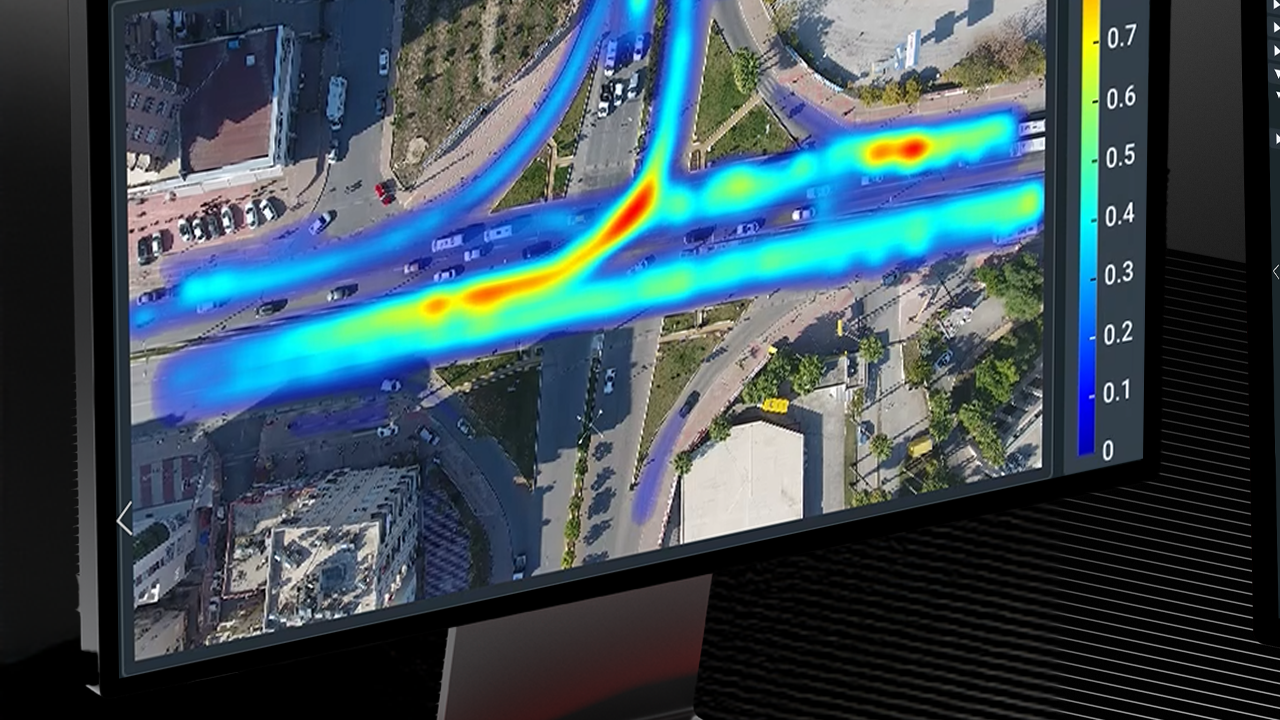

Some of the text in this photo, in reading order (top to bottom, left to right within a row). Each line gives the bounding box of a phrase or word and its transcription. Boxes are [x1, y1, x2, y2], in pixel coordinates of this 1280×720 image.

[1108, 24, 1136, 48] 0.7
[1107, 85, 1135, 109] 0.6
[1107, 144, 1135, 168] 0.5
[1106, 202, 1134, 226] 0.4
[1105, 261, 1133, 285] 0.3
[1105, 321, 1132, 345] 0.2
[1104, 379, 1129, 403] 0.1
[1103, 440, 1113, 460] 0
